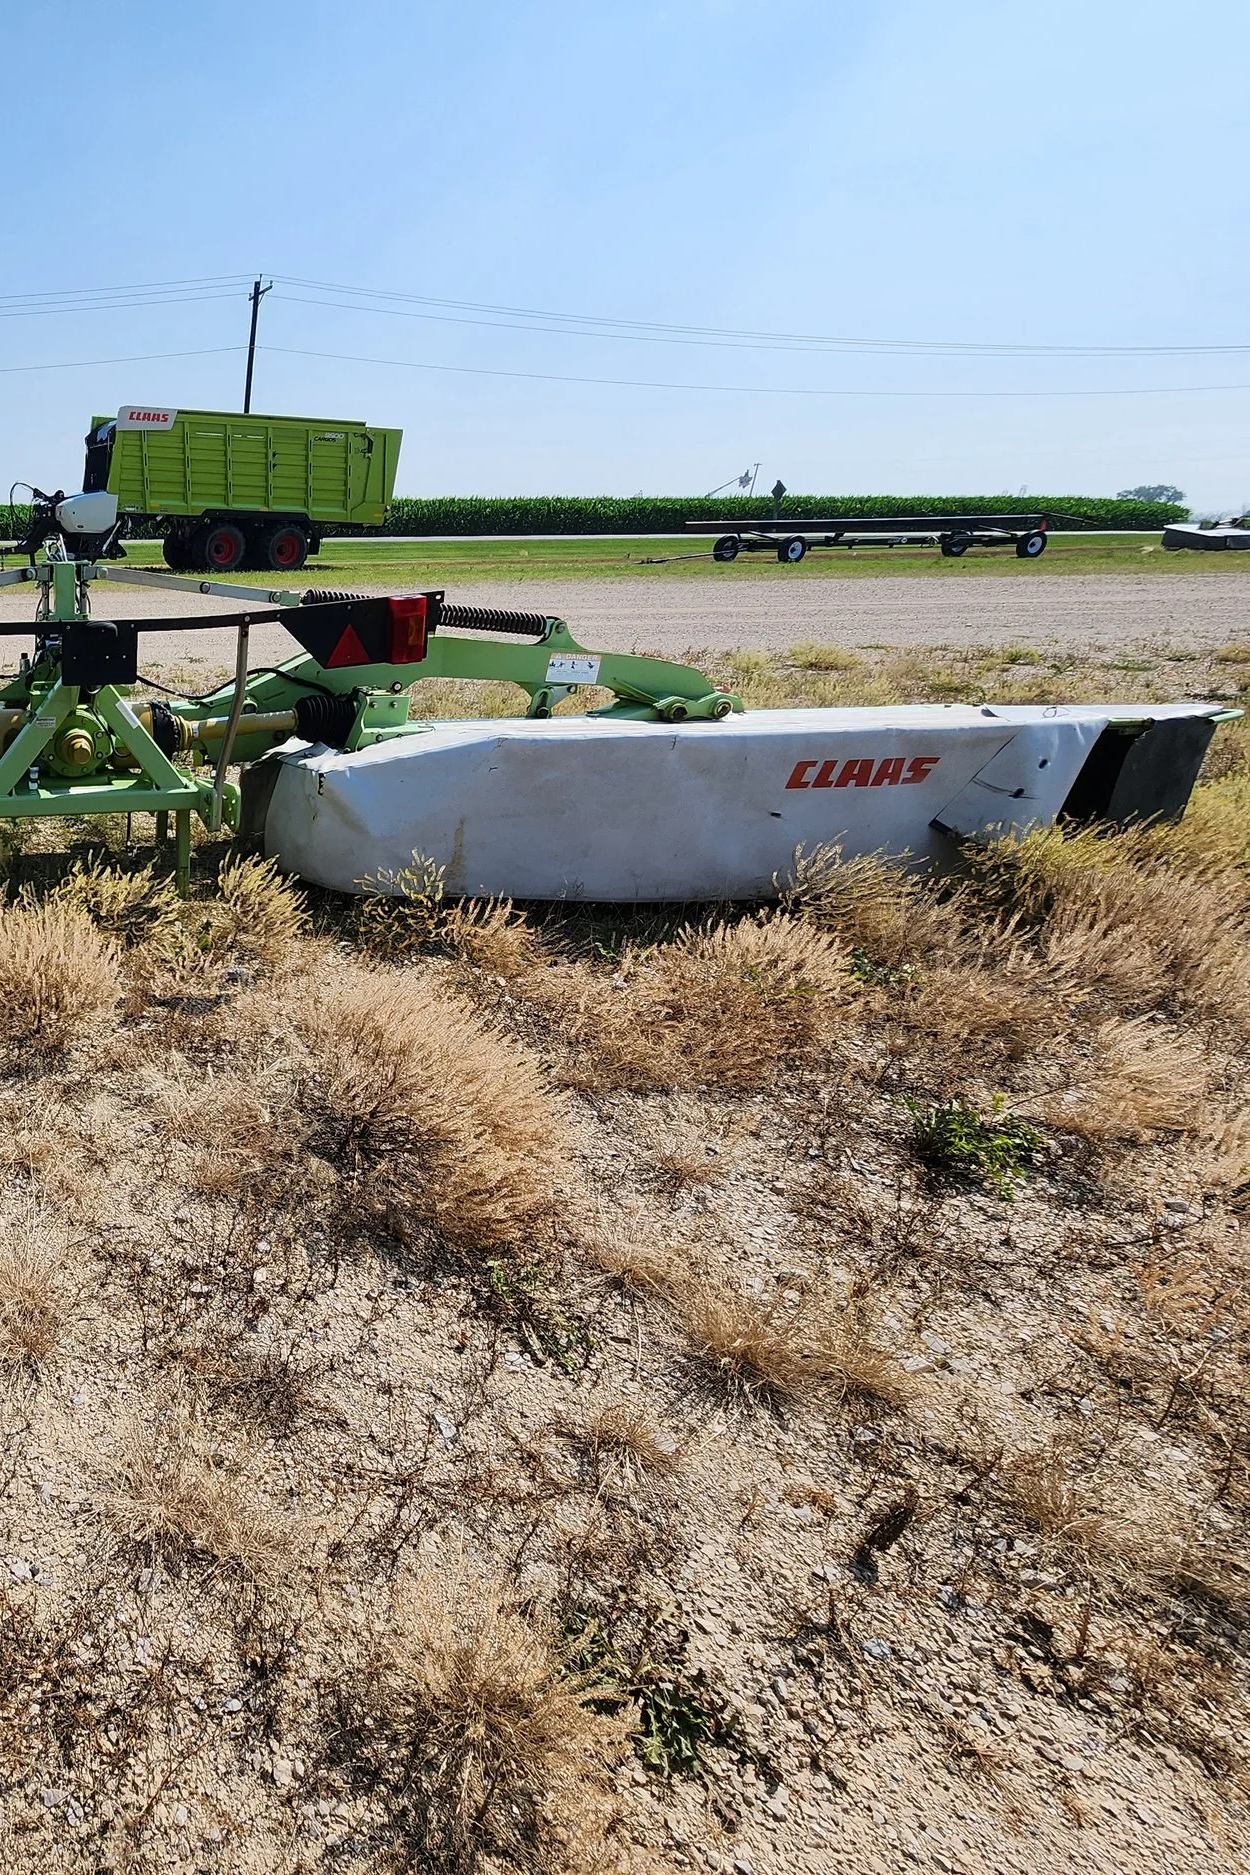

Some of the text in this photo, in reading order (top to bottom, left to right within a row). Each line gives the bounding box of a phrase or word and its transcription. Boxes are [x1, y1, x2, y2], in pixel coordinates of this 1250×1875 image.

[128, 411, 169, 423] CLAAS
[566, 653, 598, 661] DANGER
[784, 756, 942, 790] CLAAS
